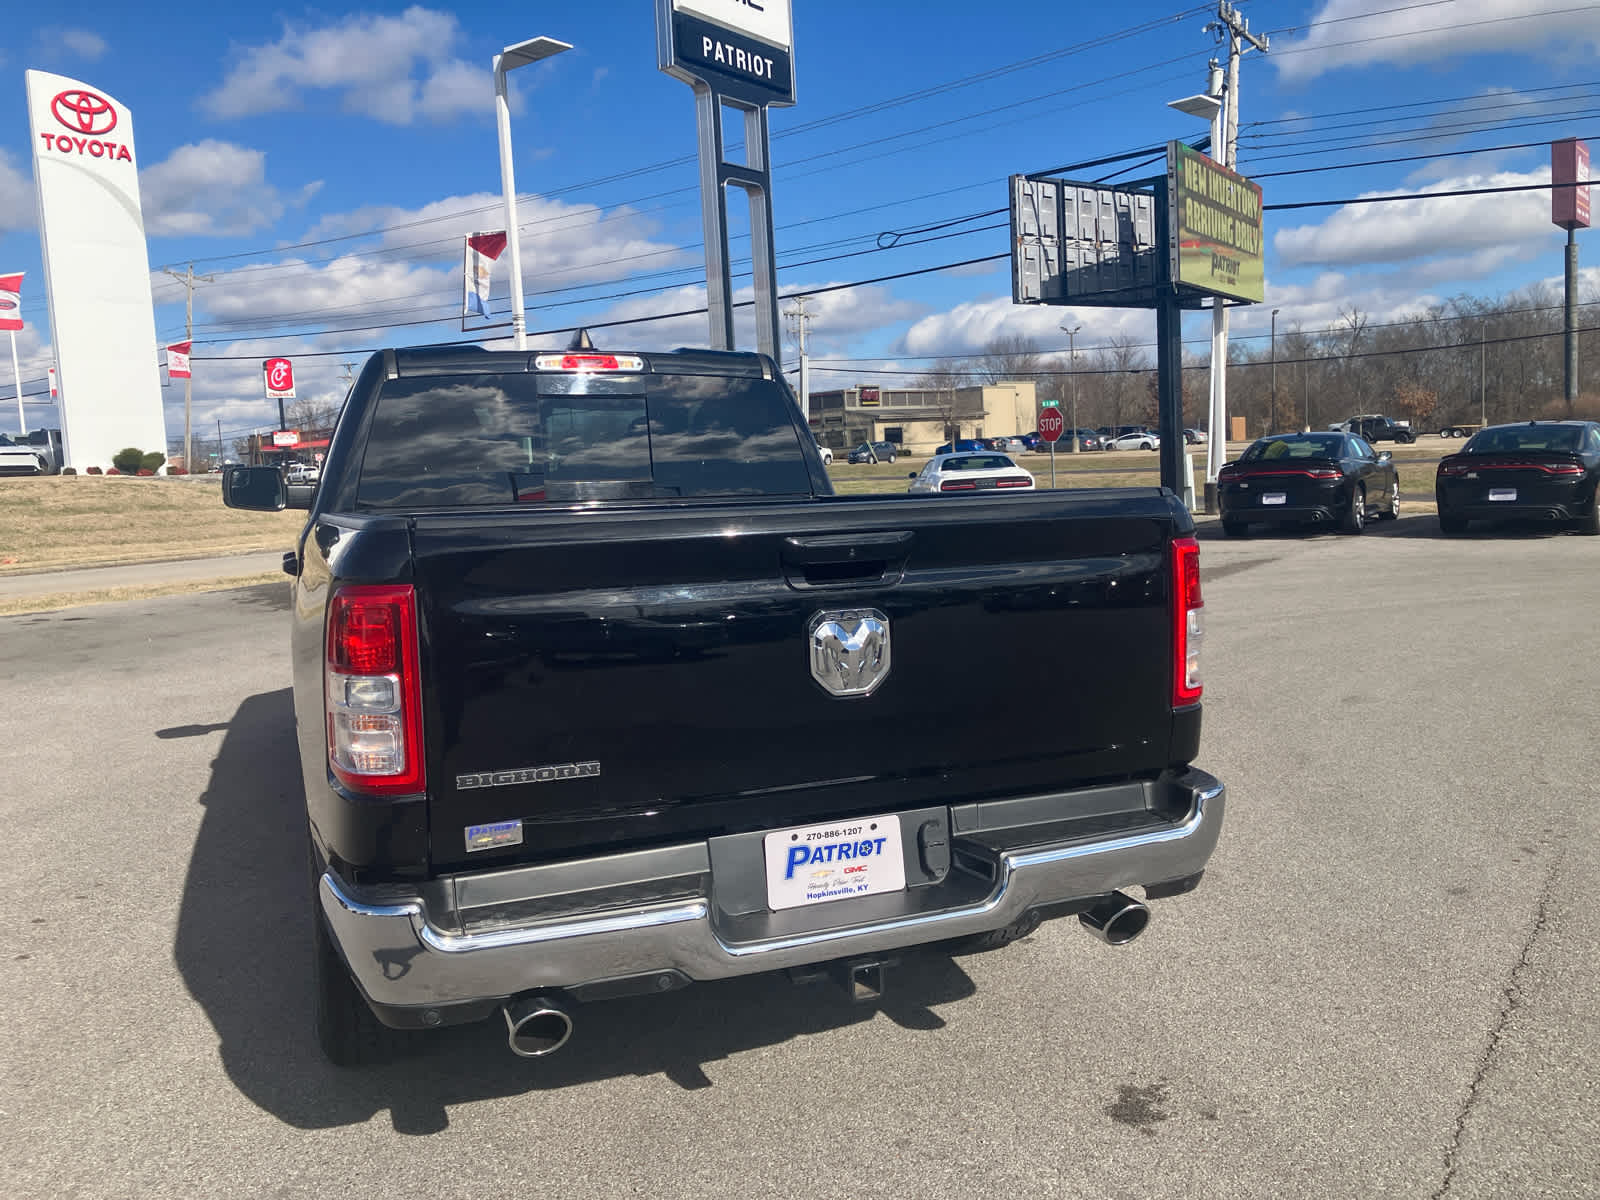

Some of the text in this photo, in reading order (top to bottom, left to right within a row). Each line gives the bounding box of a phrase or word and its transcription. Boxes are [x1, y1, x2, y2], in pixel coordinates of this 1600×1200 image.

[702, 36, 774, 79] PATRIOT
[40, 132, 132, 163] TOYOTA
[1184, 157, 1259, 220] NEW INVENTORY
[1185, 197, 1259, 256] ARRIVING DAILY
[1040, 417, 1061, 432] STOP
[456, 760, 601, 790] BIGHORN
[806, 826, 863, 841] 270-886-1207
[784, 837, 887, 880] PATRIOT
[843, 864, 868, 874] GMC
[806, 884, 869, 900] Hopkinsville, KY
